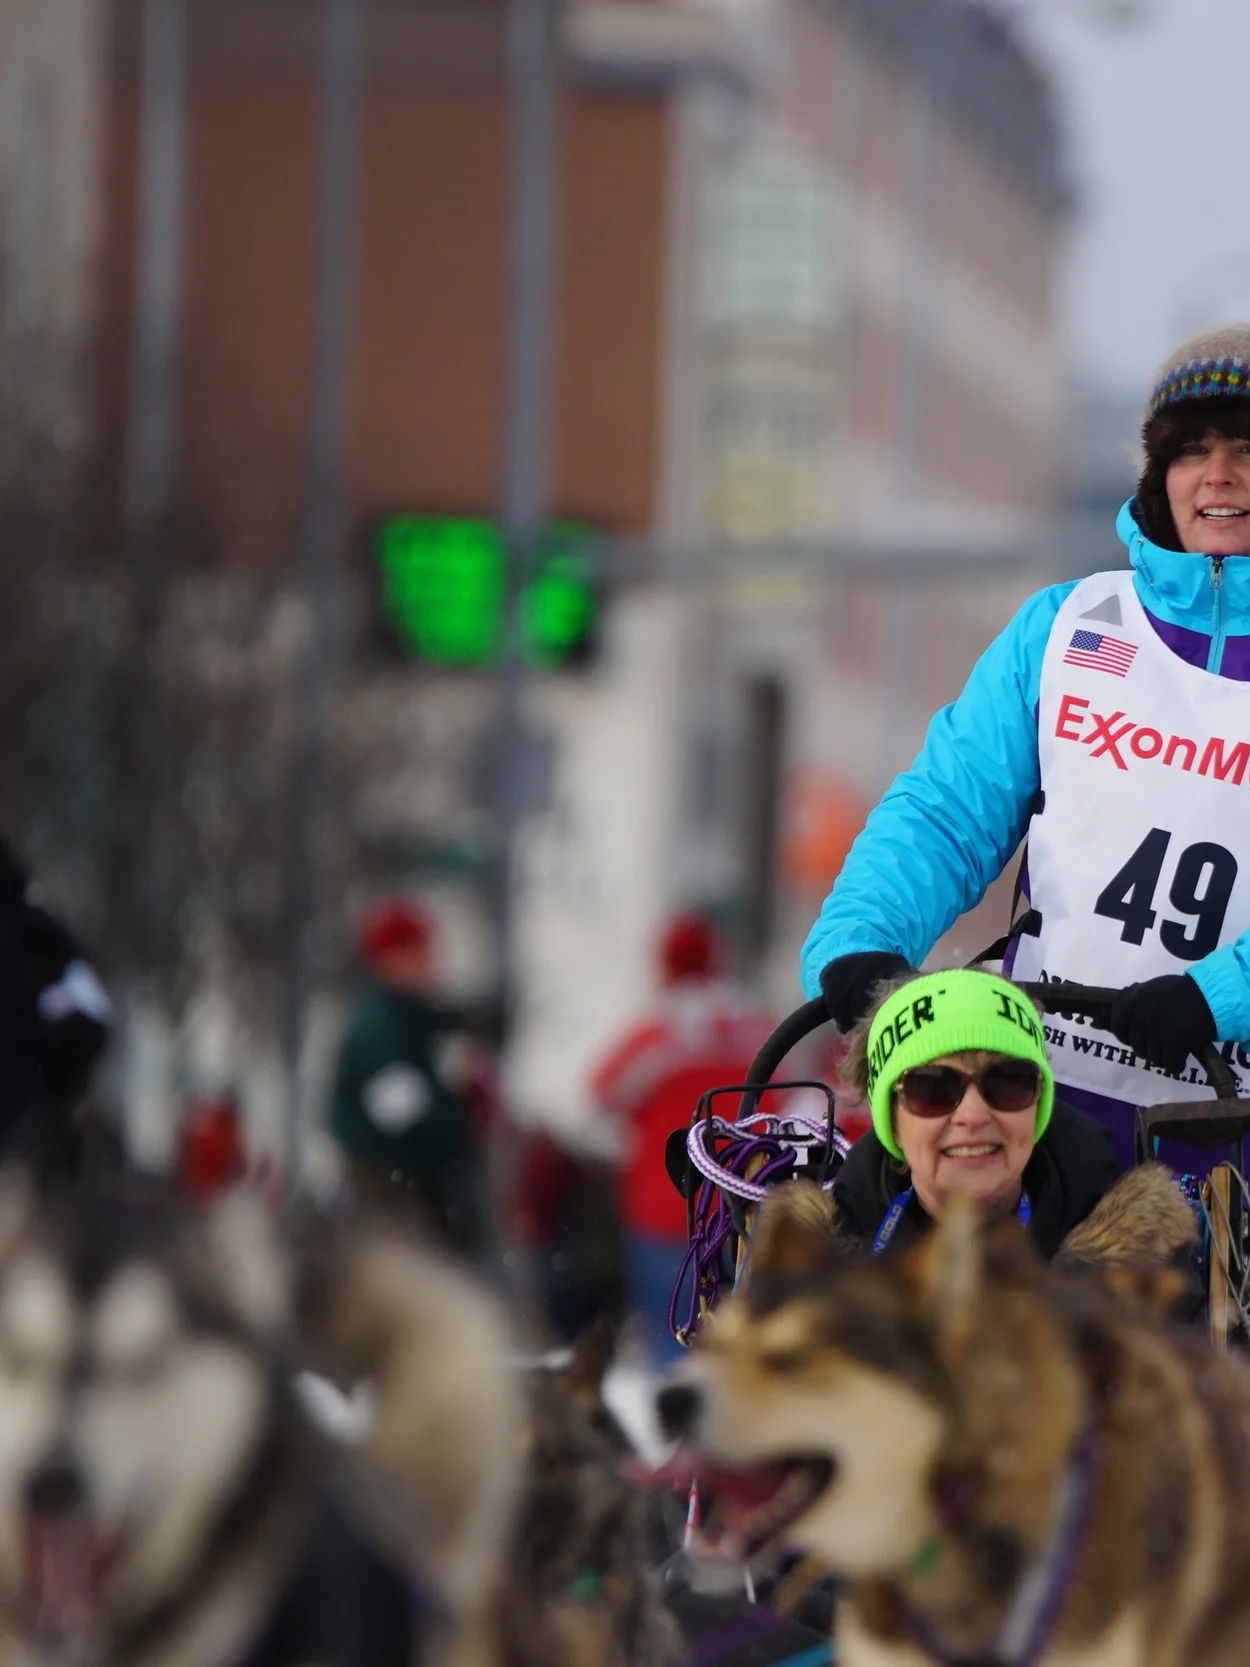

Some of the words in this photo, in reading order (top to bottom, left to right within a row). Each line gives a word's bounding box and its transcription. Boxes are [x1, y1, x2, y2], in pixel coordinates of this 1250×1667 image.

[1093, 827, 1238, 961] 49
[1042, 1025, 1067, 1047] SH
[1071, 1034, 1137, 1067] WITH
[880, 1204, 903, 1241] GOLD
